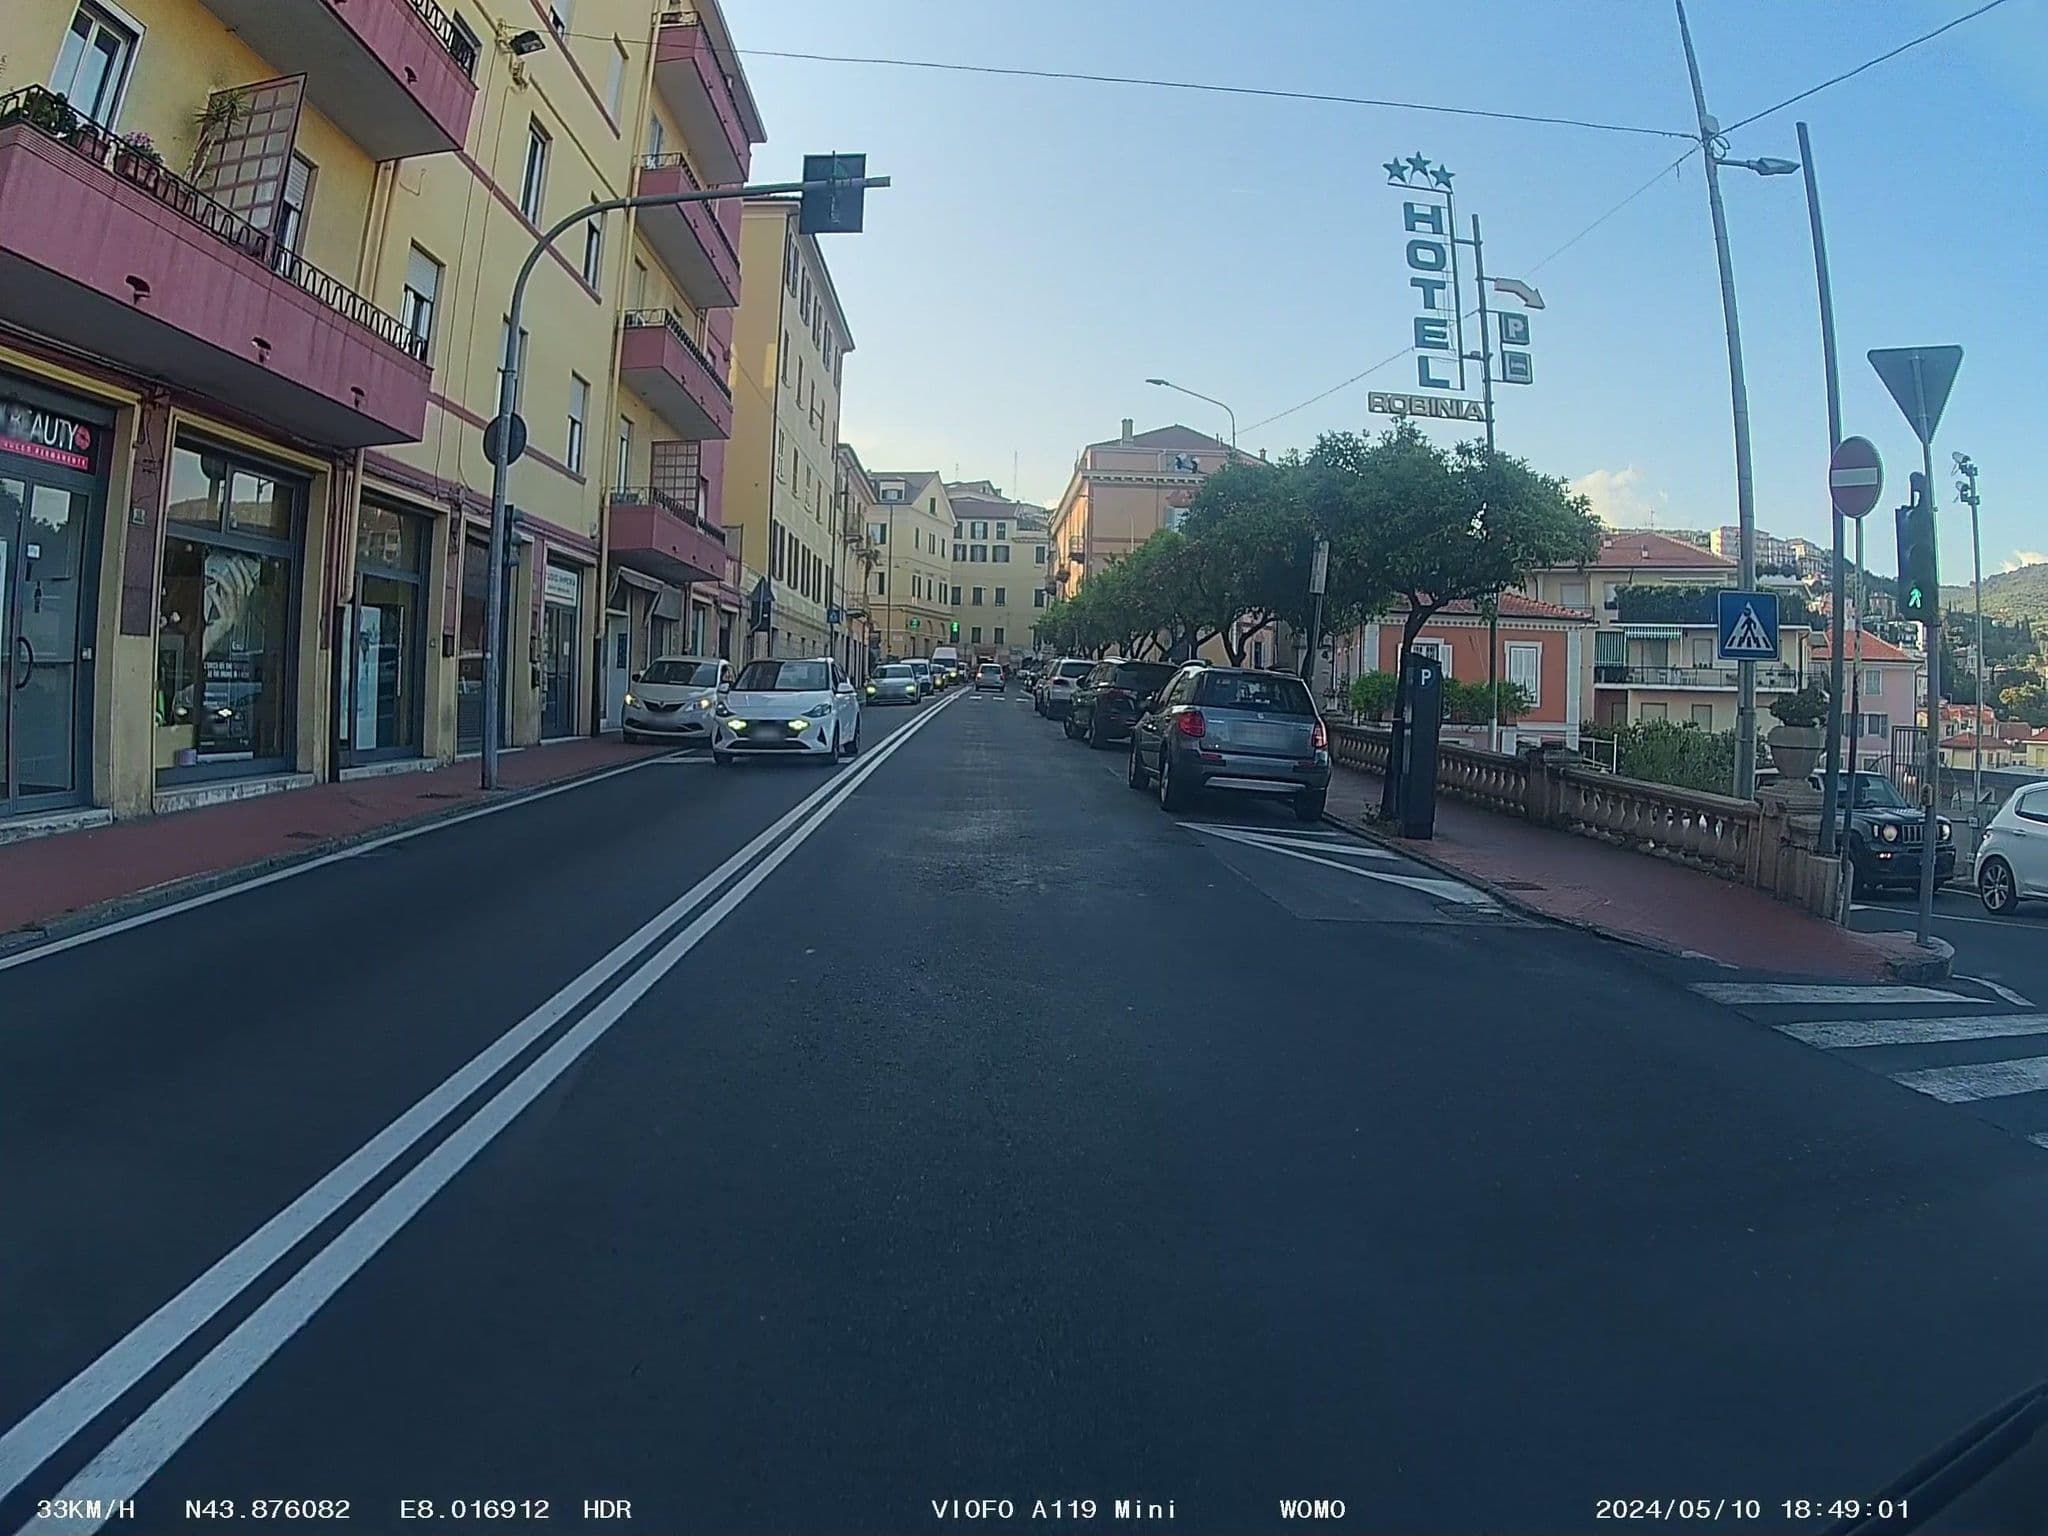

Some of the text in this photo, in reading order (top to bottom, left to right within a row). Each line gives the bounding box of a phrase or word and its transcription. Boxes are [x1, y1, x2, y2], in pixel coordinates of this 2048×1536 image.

[1403, 201, 1450, 389] HOTEL
[1369, 392, 1484, 420] ROBINIA
[1421, 668, 1432, 686] P
